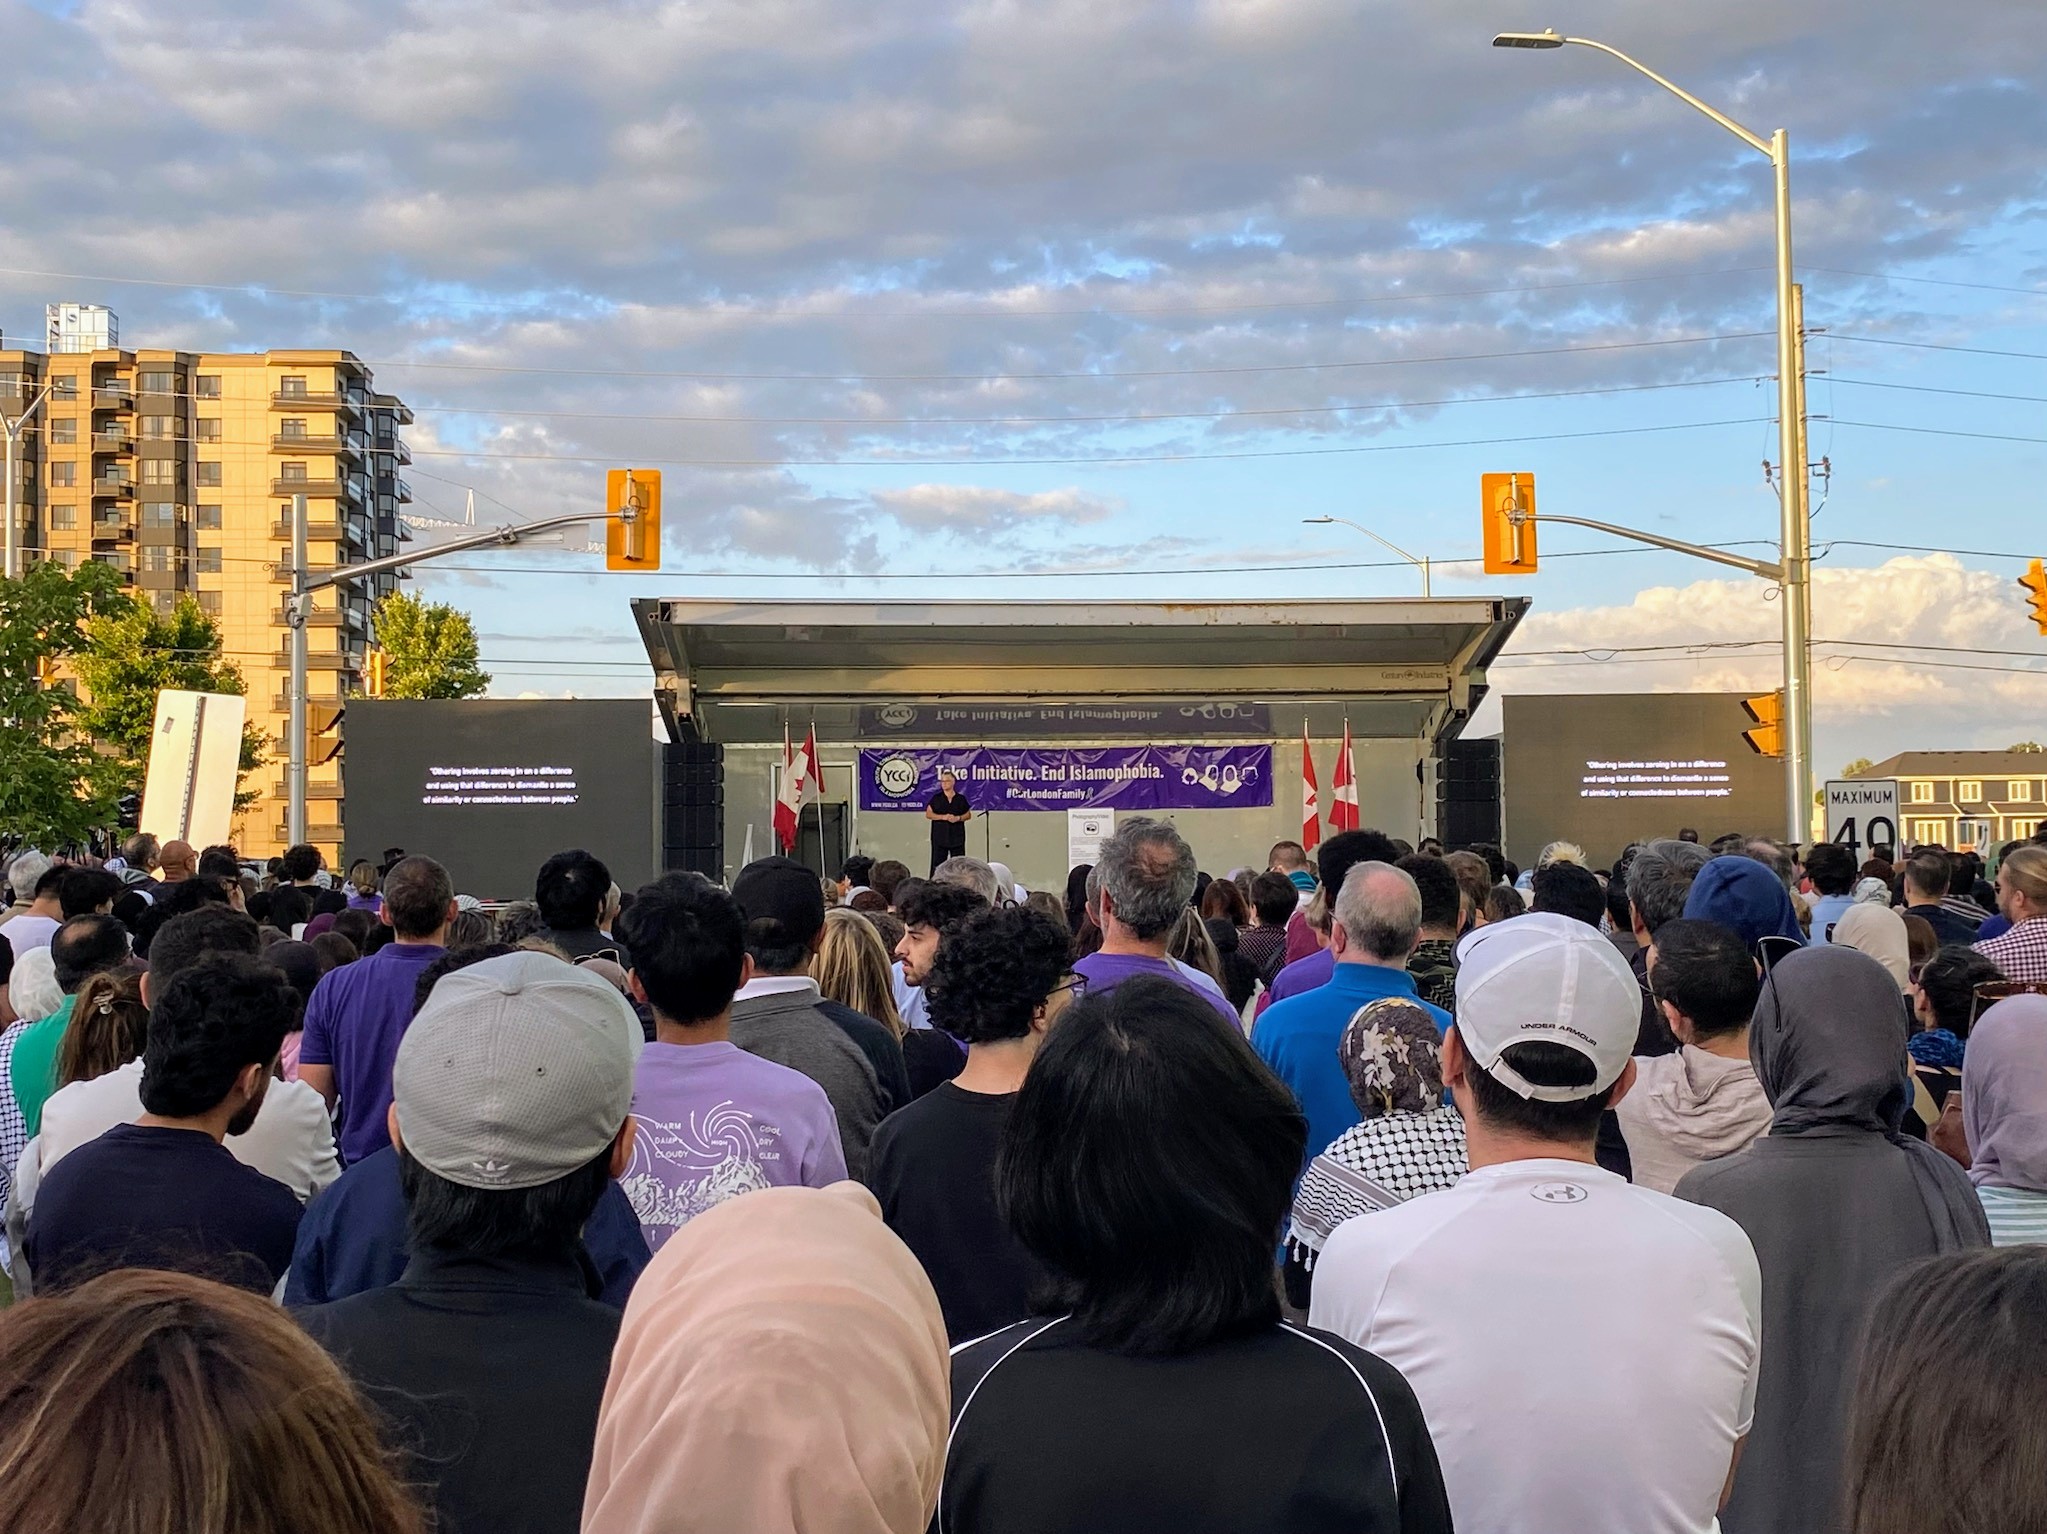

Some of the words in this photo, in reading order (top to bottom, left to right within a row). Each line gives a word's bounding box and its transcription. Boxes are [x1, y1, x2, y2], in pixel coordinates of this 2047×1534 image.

[972, 764, 1036, 780] Initiative.
[1041, 765, 1065, 780] End
[1070, 763, 1164, 783] Islamophobia.
[1831, 790, 1892, 804] MAXIMUM
[1832, 816, 1896, 850] 40
[1558, 1025, 1597, 1046] ARMOUR
[760, 1125, 782, 1136] COOL
